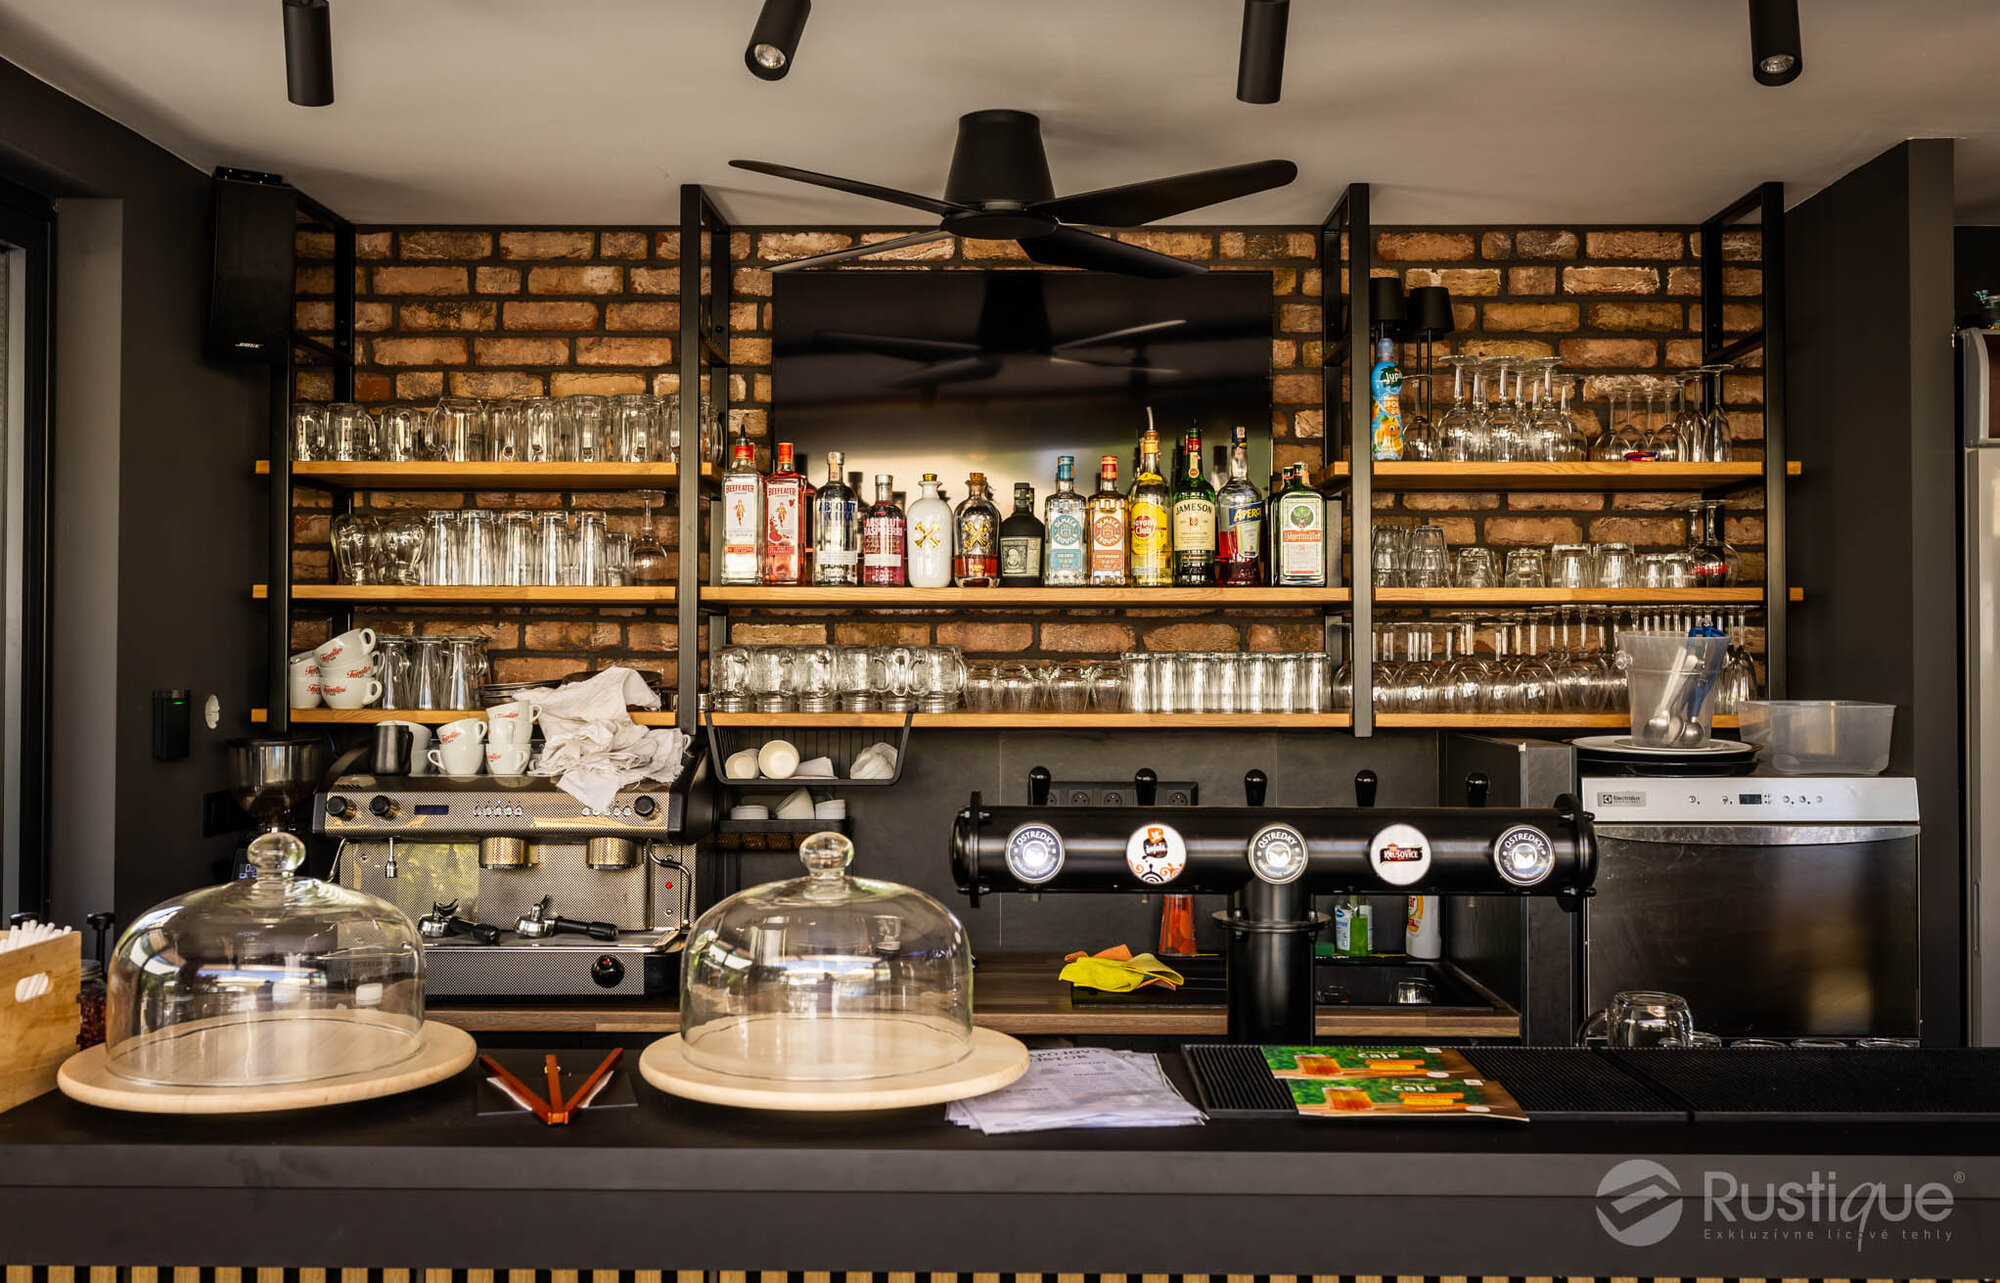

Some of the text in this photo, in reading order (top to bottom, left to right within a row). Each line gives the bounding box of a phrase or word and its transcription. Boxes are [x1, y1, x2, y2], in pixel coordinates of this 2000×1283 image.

[726, 484, 755, 493] BEEFEATER
[768, 487, 796, 496] BEEFEATER
[819, 501, 856, 512] ABOLUT
[1175, 503, 1212, 515] JAMESON
[1234, 507, 1261, 522] APERO
[1055, 517, 1077, 528] OLMECA
[1096, 518, 1119, 529] OLMECA
[1055, 534, 1078, 544] TEQUILA
[1097, 534, 1120, 545] TEQUILA
[1016, 831, 1056, 846] OSTREDKY
[1257, 831, 1298, 849] OSTREDKY
[1504, 833, 1545, 850] OSTREDKY
